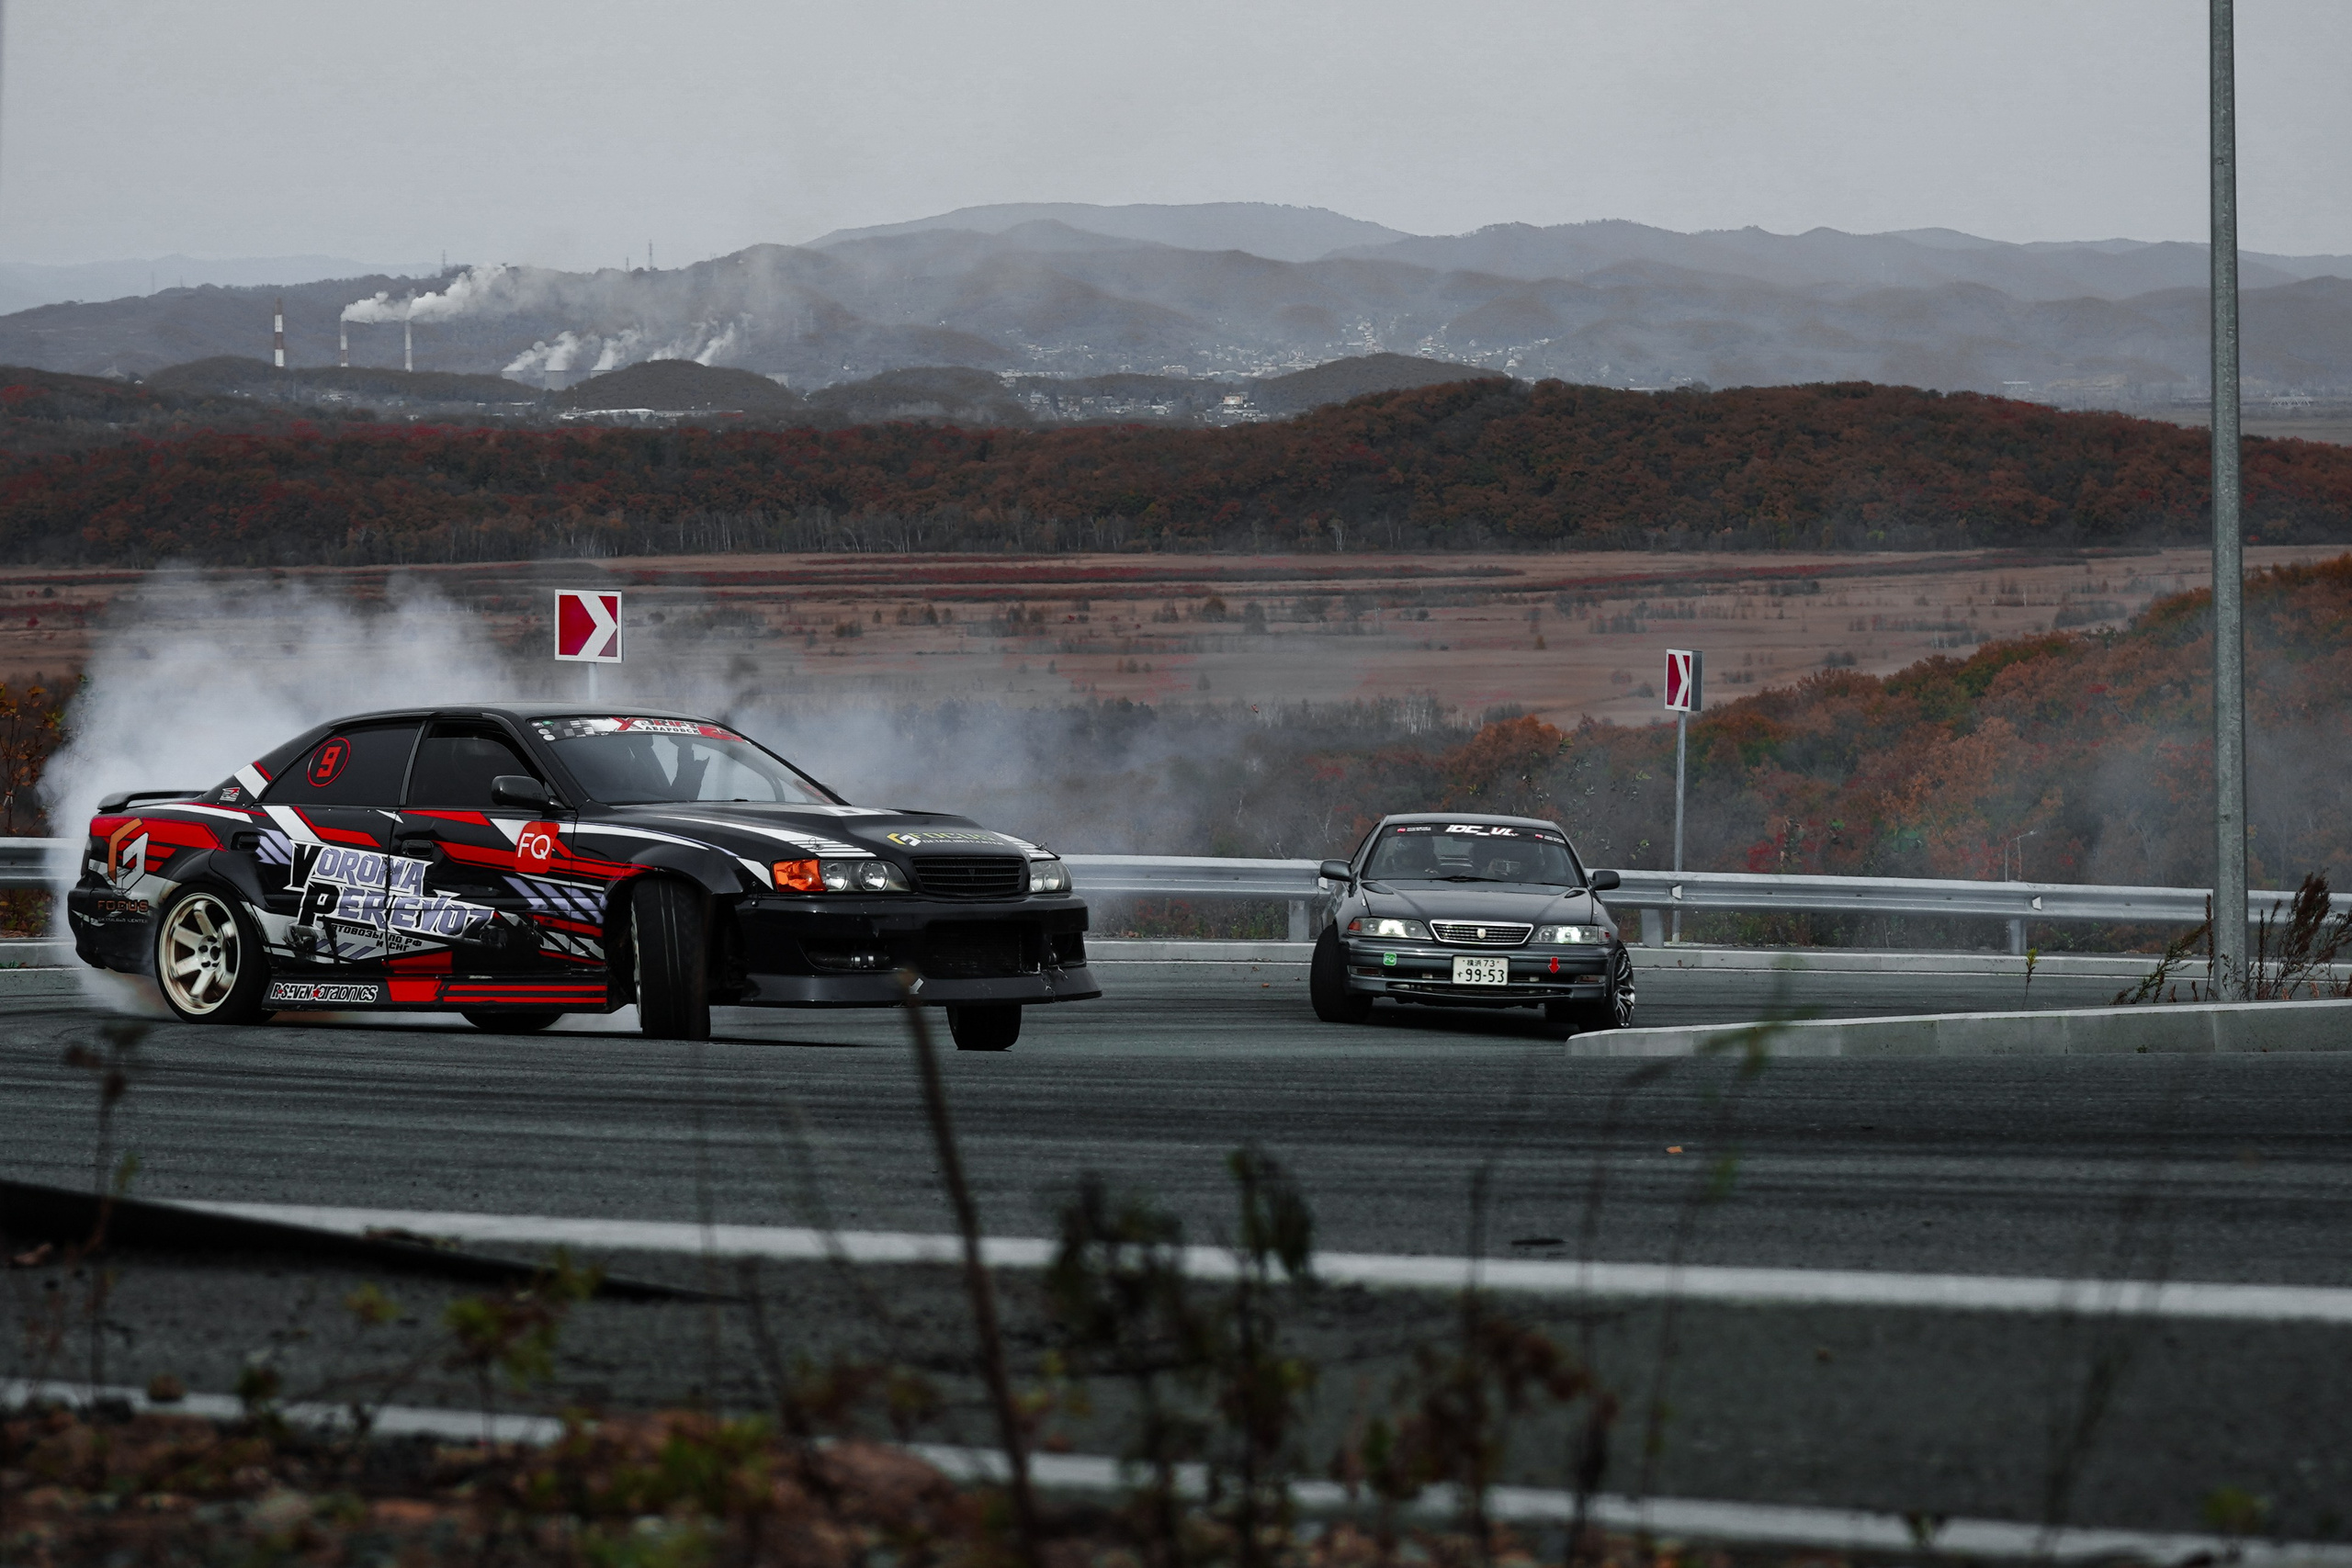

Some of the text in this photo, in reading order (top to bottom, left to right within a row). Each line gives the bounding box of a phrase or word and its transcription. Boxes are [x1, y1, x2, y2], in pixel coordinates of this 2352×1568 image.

[316, 746, 342, 777] 9
[908, 832, 995, 841] FOCUS
[517, 832, 551, 860] FQ
[97, 900, 149, 911] FOCUS
[298, 881, 494, 940] PEREVOZ
[376, 940, 410, 952] И СНГ
[389, 934, 402, 942] ПО
[404, 938, 423, 947] РФ
[1483, 959, 1496, 967] 73
[1465, 968, 1505, 983] 99-53
